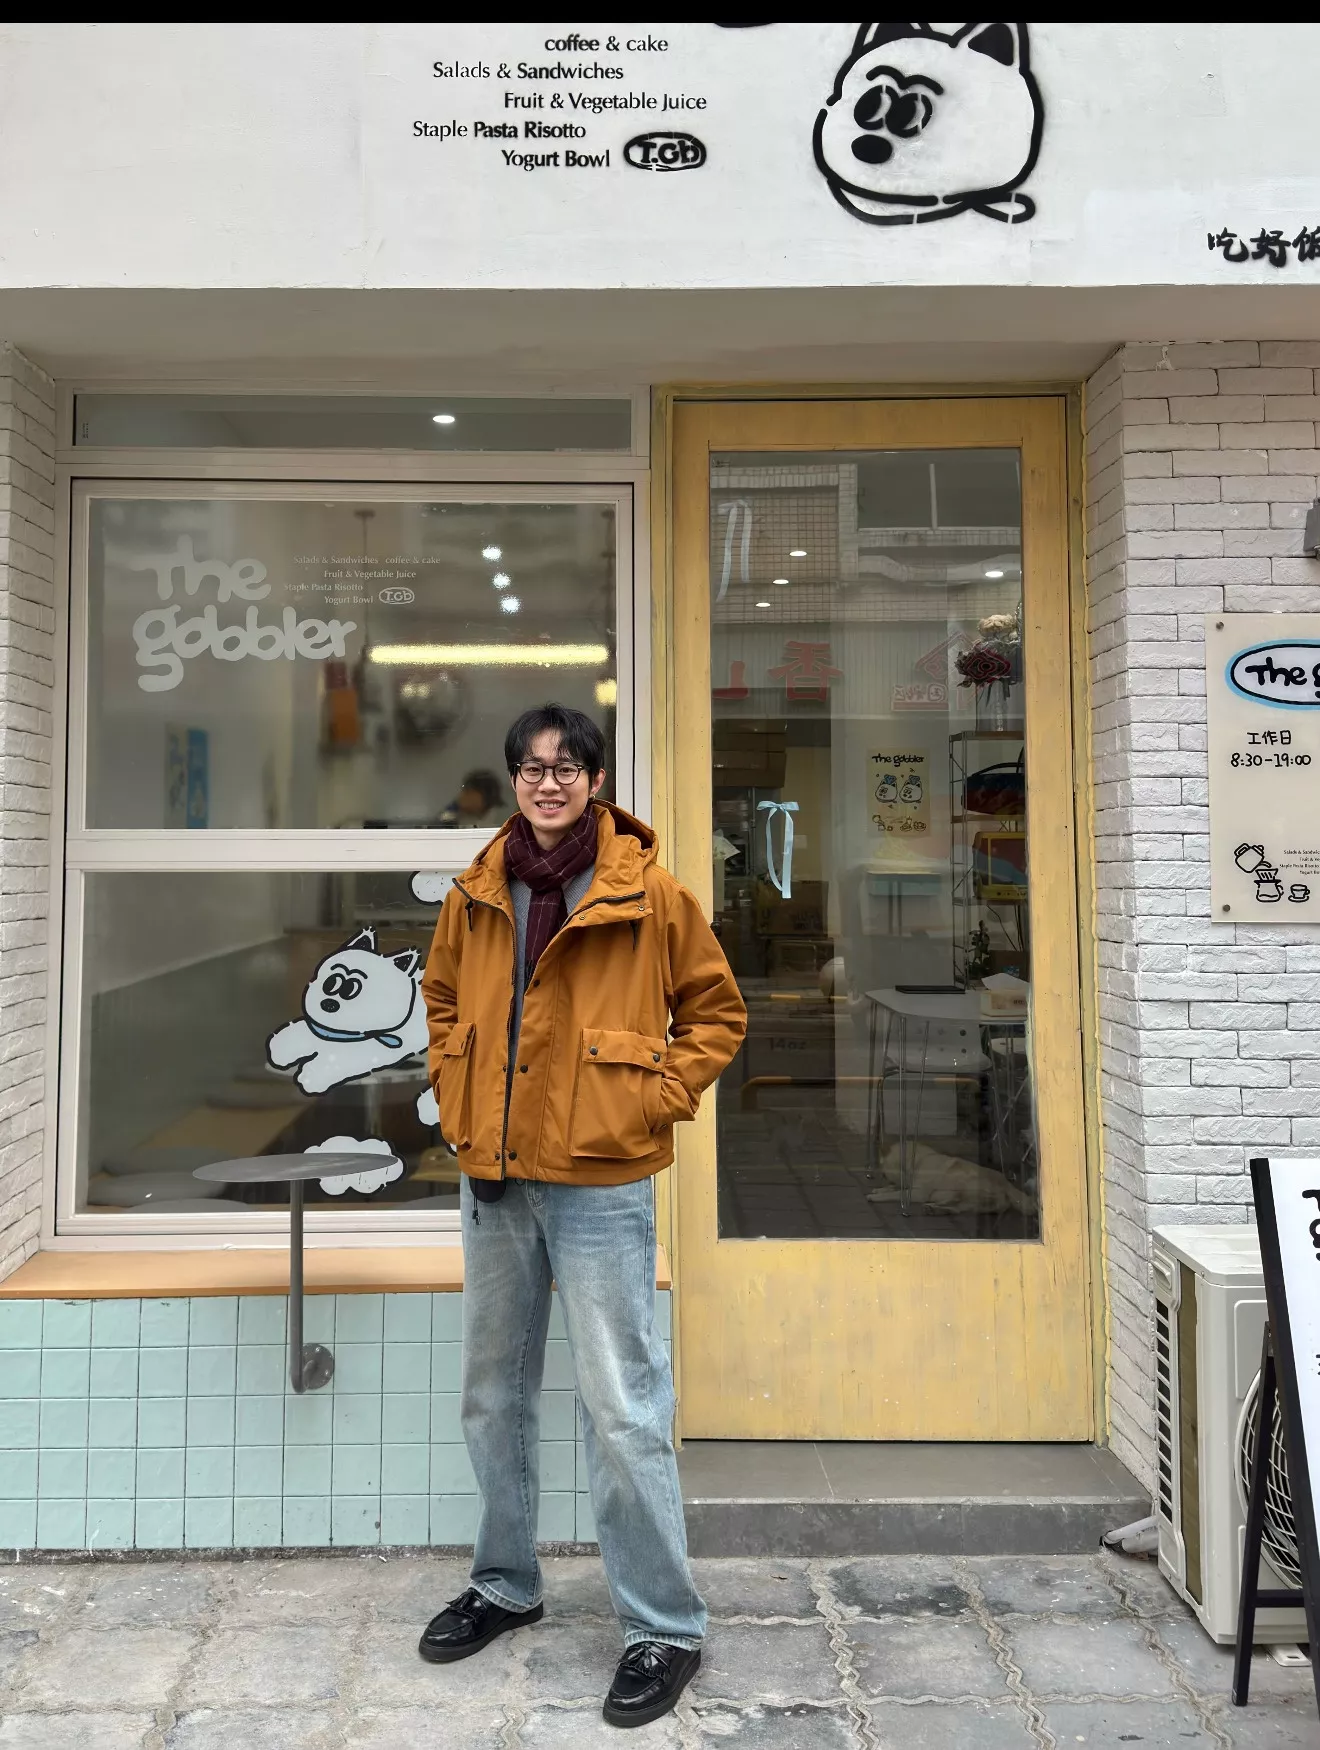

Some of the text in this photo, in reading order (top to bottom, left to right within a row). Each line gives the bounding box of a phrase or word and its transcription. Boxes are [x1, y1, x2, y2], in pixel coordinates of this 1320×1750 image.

[545, 34, 669, 52] coffee & cake
[433, 61, 624, 80] Salads & Sandwiches
[504, 92, 707, 114] Fruit & Vegetable Juice
[413, 120, 586, 141] Staple Pasta Risotto
[501, 149, 560, 172] Yogurt
[565, 149, 610, 168] Bowl
[130, 534, 271, 602] The
[293, 555, 441, 564] Salads & Sandwiches coffee & cake
[324, 570, 343, 578] Fruit
[354, 570, 394, 580] Vegetable
[396, 570, 417, 579] Juice
[284, 582, 363, 592] Staple Pasta Risotto
[324, 595, 350, 606] Yogurt
[353, 595, 374, 604] Bowl
[132, 604, 358, 692] gobbler
[1245, 656, 1307, 686] The
[1247, 730, 1292, 745] 工作日
[872, 753, 924, 767] The gobbler
[1231, 753, 1312, 767] 8:30-19:00
